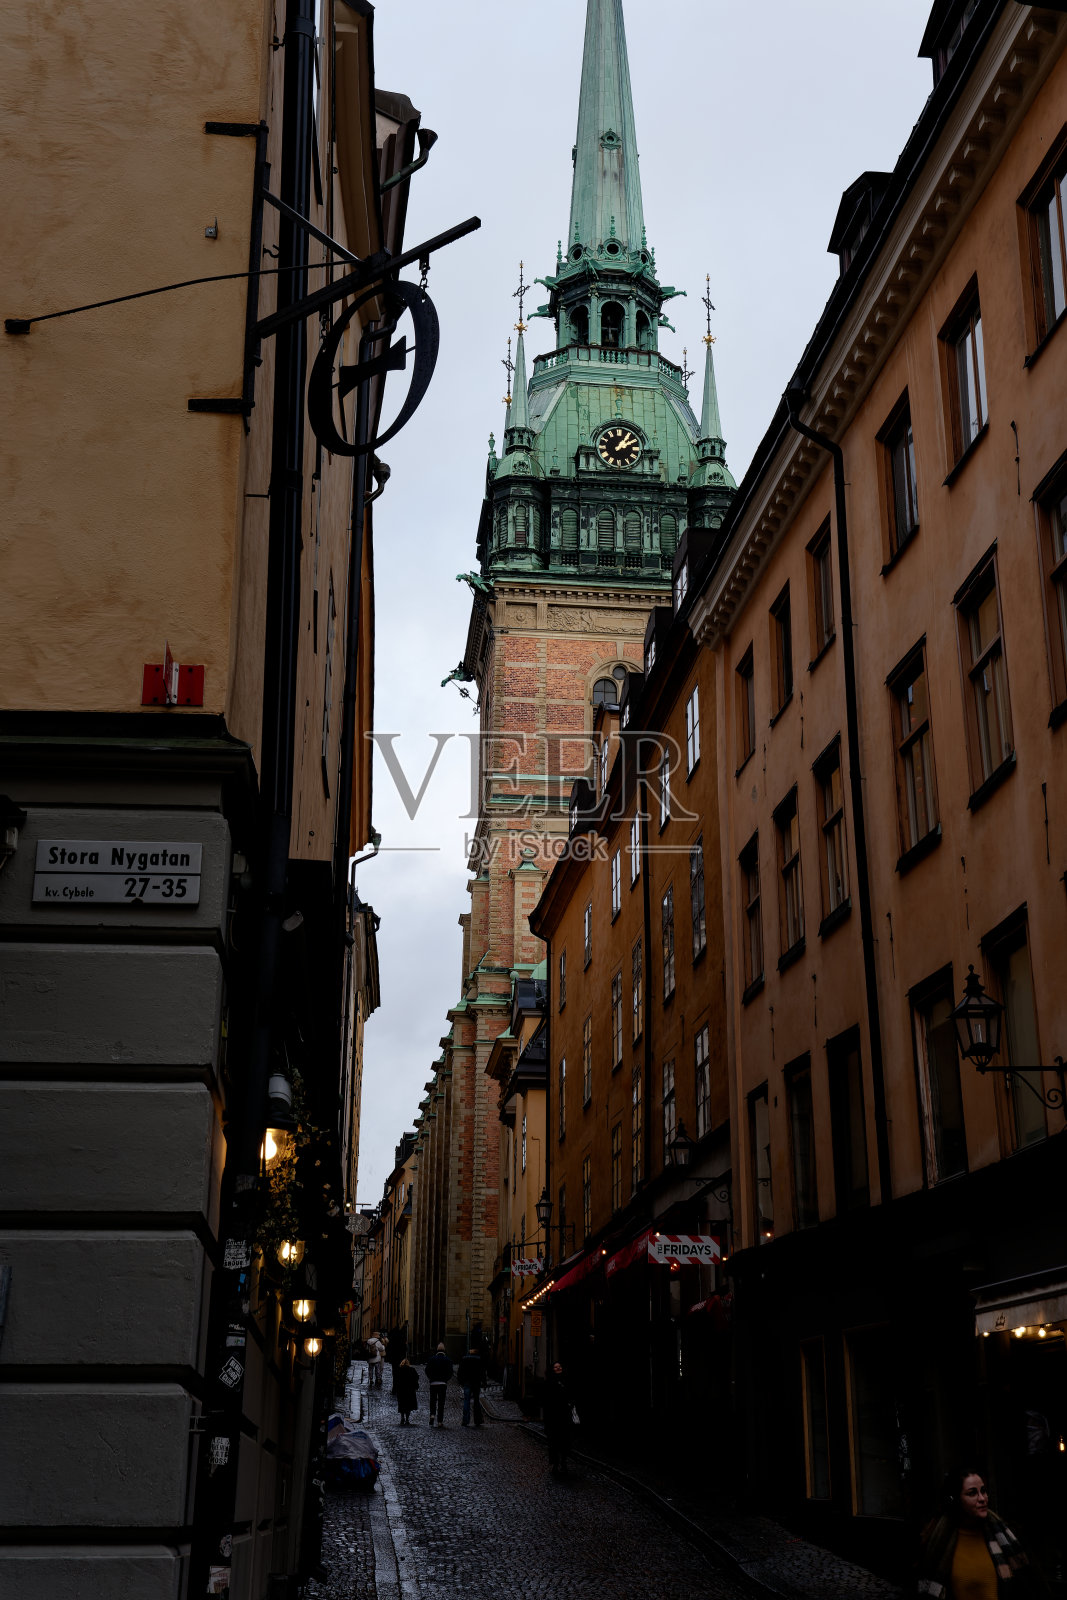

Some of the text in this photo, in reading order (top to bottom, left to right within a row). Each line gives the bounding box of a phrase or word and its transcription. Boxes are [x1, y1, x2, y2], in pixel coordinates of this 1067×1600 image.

[48, 847, 190, 871] Stora Nygatan
[45, 887, 94, 900] kv. Cybele
[124, 878, 187, 898] 27-35
[663, 1244, 711, 1256] FRIDAYS
